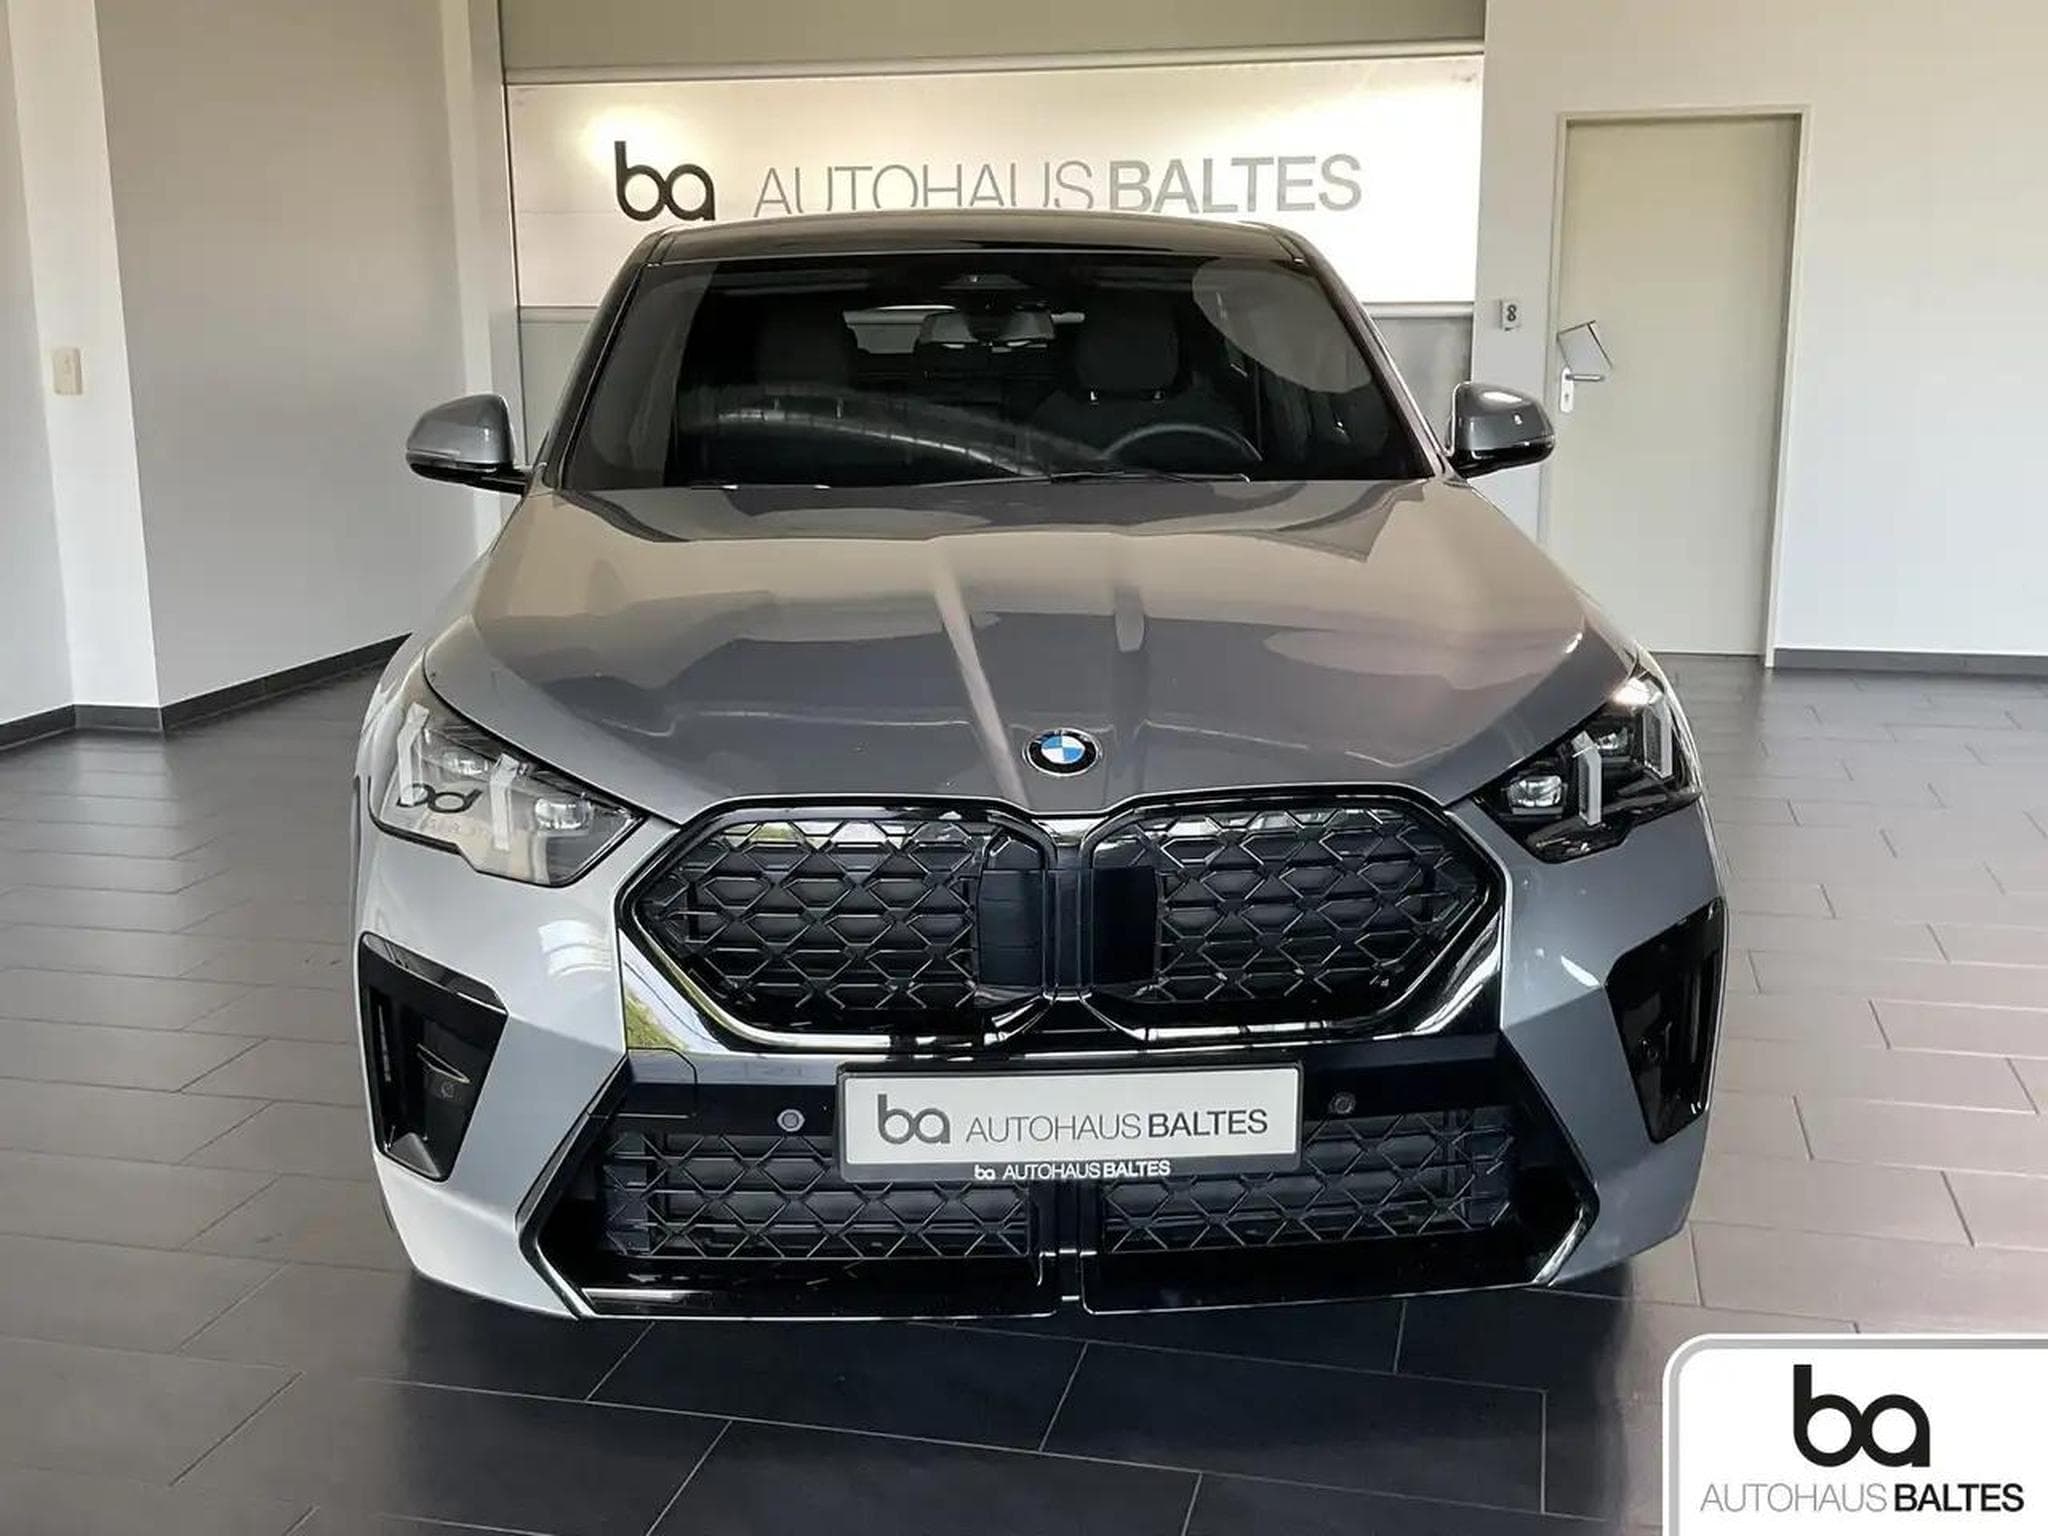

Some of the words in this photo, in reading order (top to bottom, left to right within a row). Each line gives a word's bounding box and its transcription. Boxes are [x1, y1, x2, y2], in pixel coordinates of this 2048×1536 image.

[613, 140, 716, 221] ba
[753, 160, 1094, 218] AUTOHAUS
[1109, 153, 1363, 214] BALTES
[877, 1093, 950, 1145] ba
[965, 1113, 1142, 1143] AUTOHAUS
[1147, 1108, 1268, 1138] BALTES
[974, 1164, 996, 1181] ba
[1002, 1162, 1100, 1180] AUTOHAUS
[1102, 1159, 1171, 1179] BALTES
